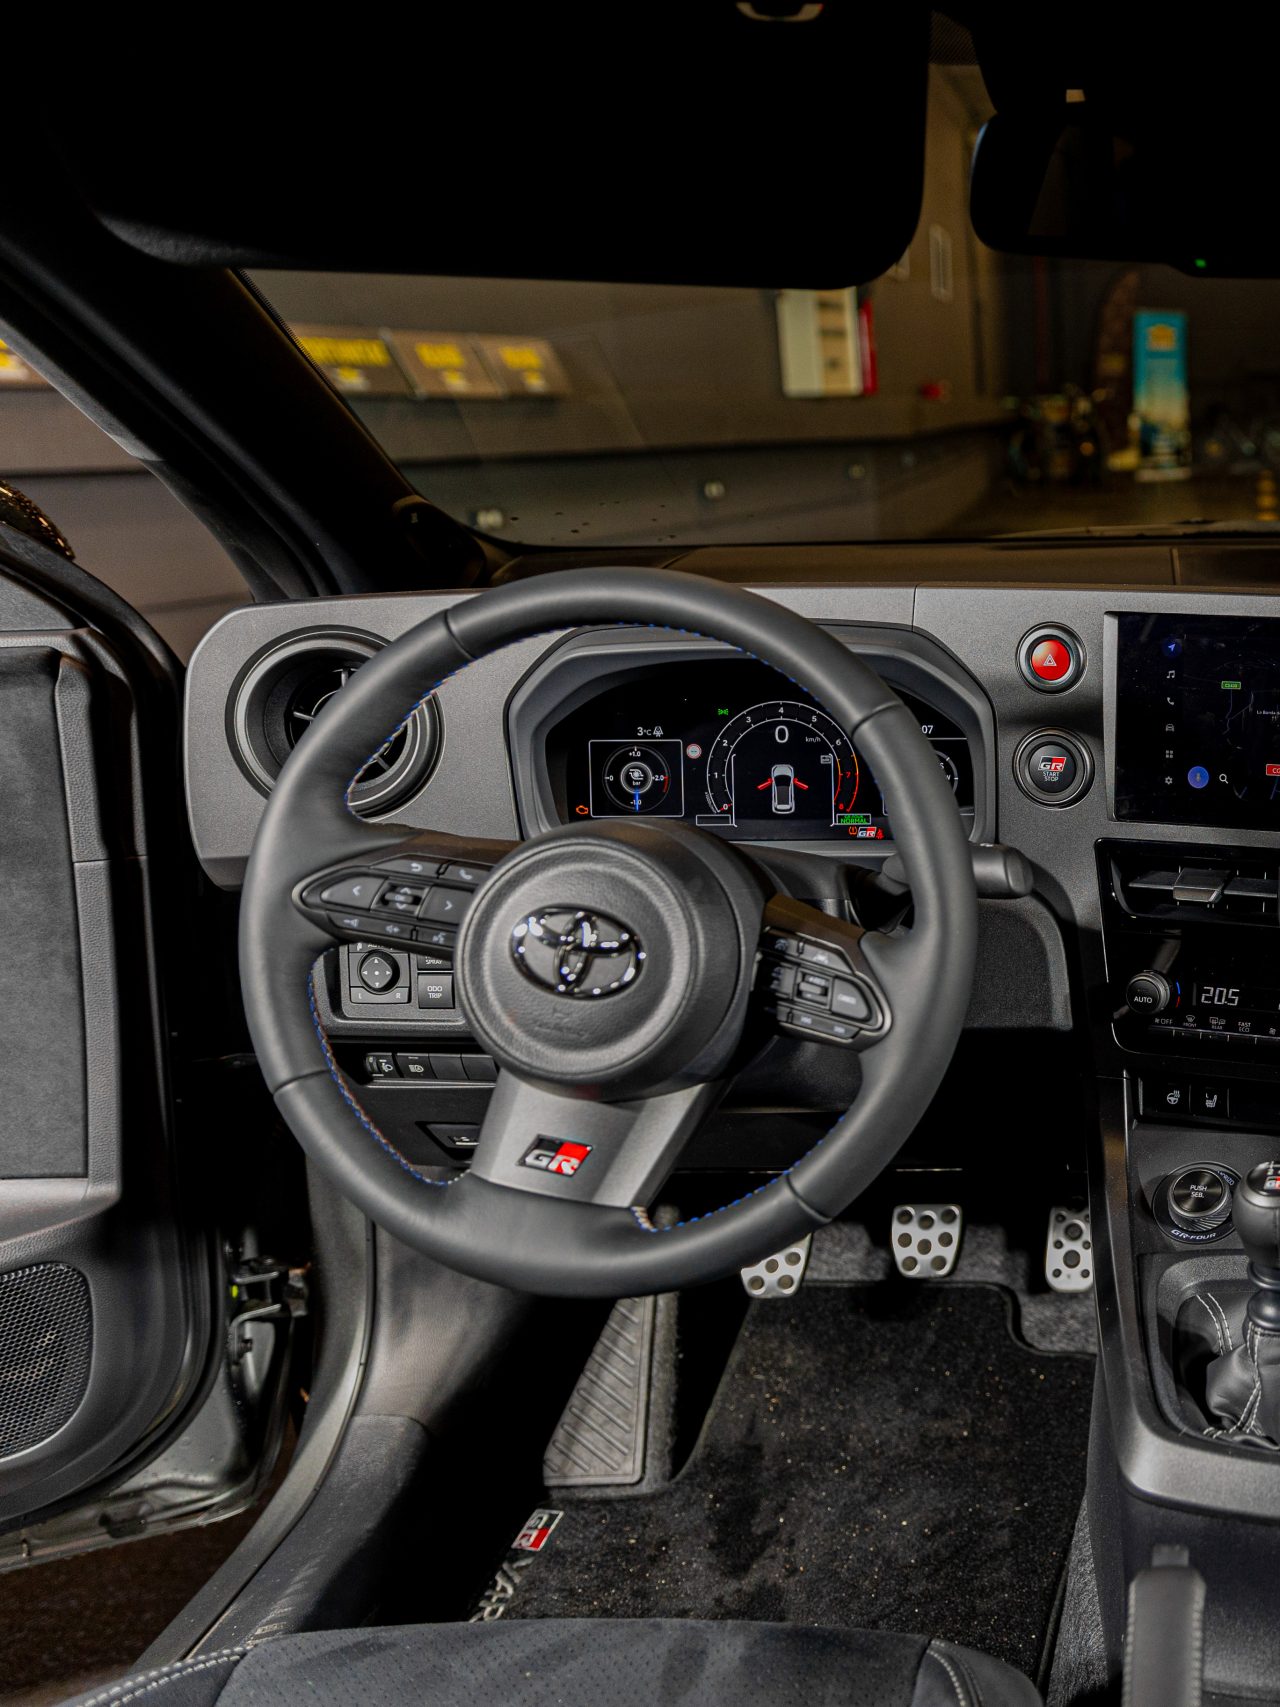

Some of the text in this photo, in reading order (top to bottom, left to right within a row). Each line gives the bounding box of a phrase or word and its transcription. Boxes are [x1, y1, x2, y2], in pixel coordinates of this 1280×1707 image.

[775, 725, 789, 743] 0
[722, 739, 728, 747] 2
[1133, 995, 1153, 1004] AUTO
[1190, 1184, 1208, 1192] PUSH
[1170, 1229, 1217, 1240] GR-FOUR
